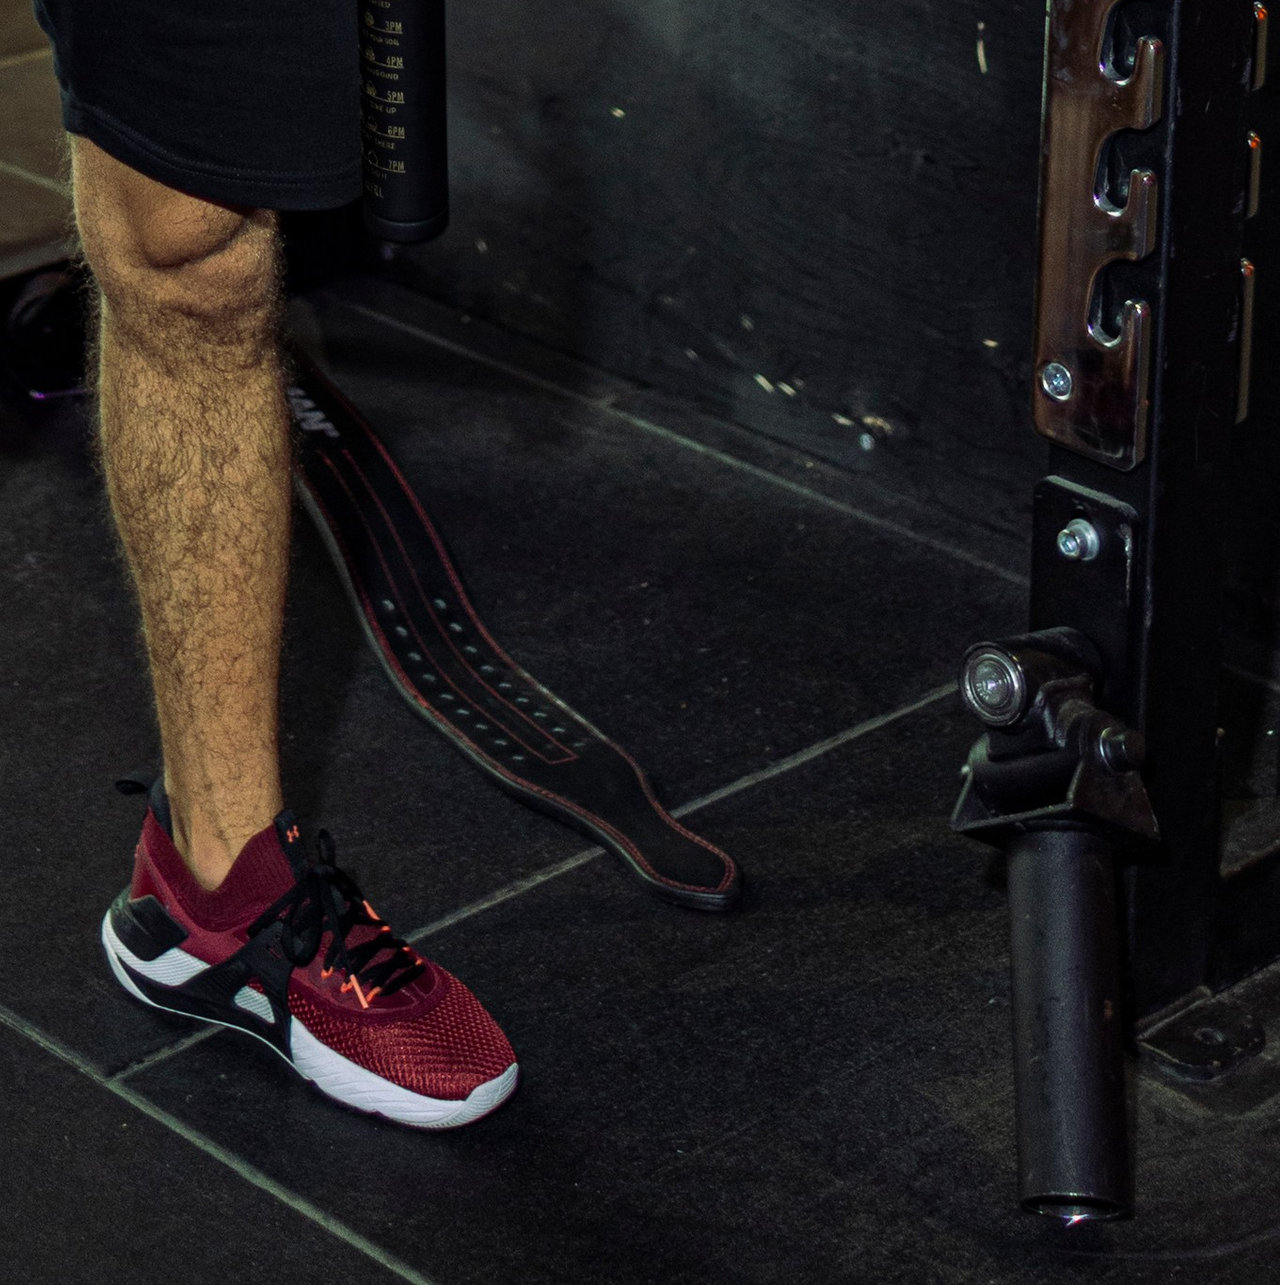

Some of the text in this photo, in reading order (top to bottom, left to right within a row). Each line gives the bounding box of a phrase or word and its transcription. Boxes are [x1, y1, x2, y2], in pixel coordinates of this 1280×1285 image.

[385, 20, 402, 32] 3PM
[386, 56, 404, 68] 4PM
[387, 90, 404, 102] 5PM
[387, 125, 405, 137] 6PM
[388, 159, 405, 171] 7PM
